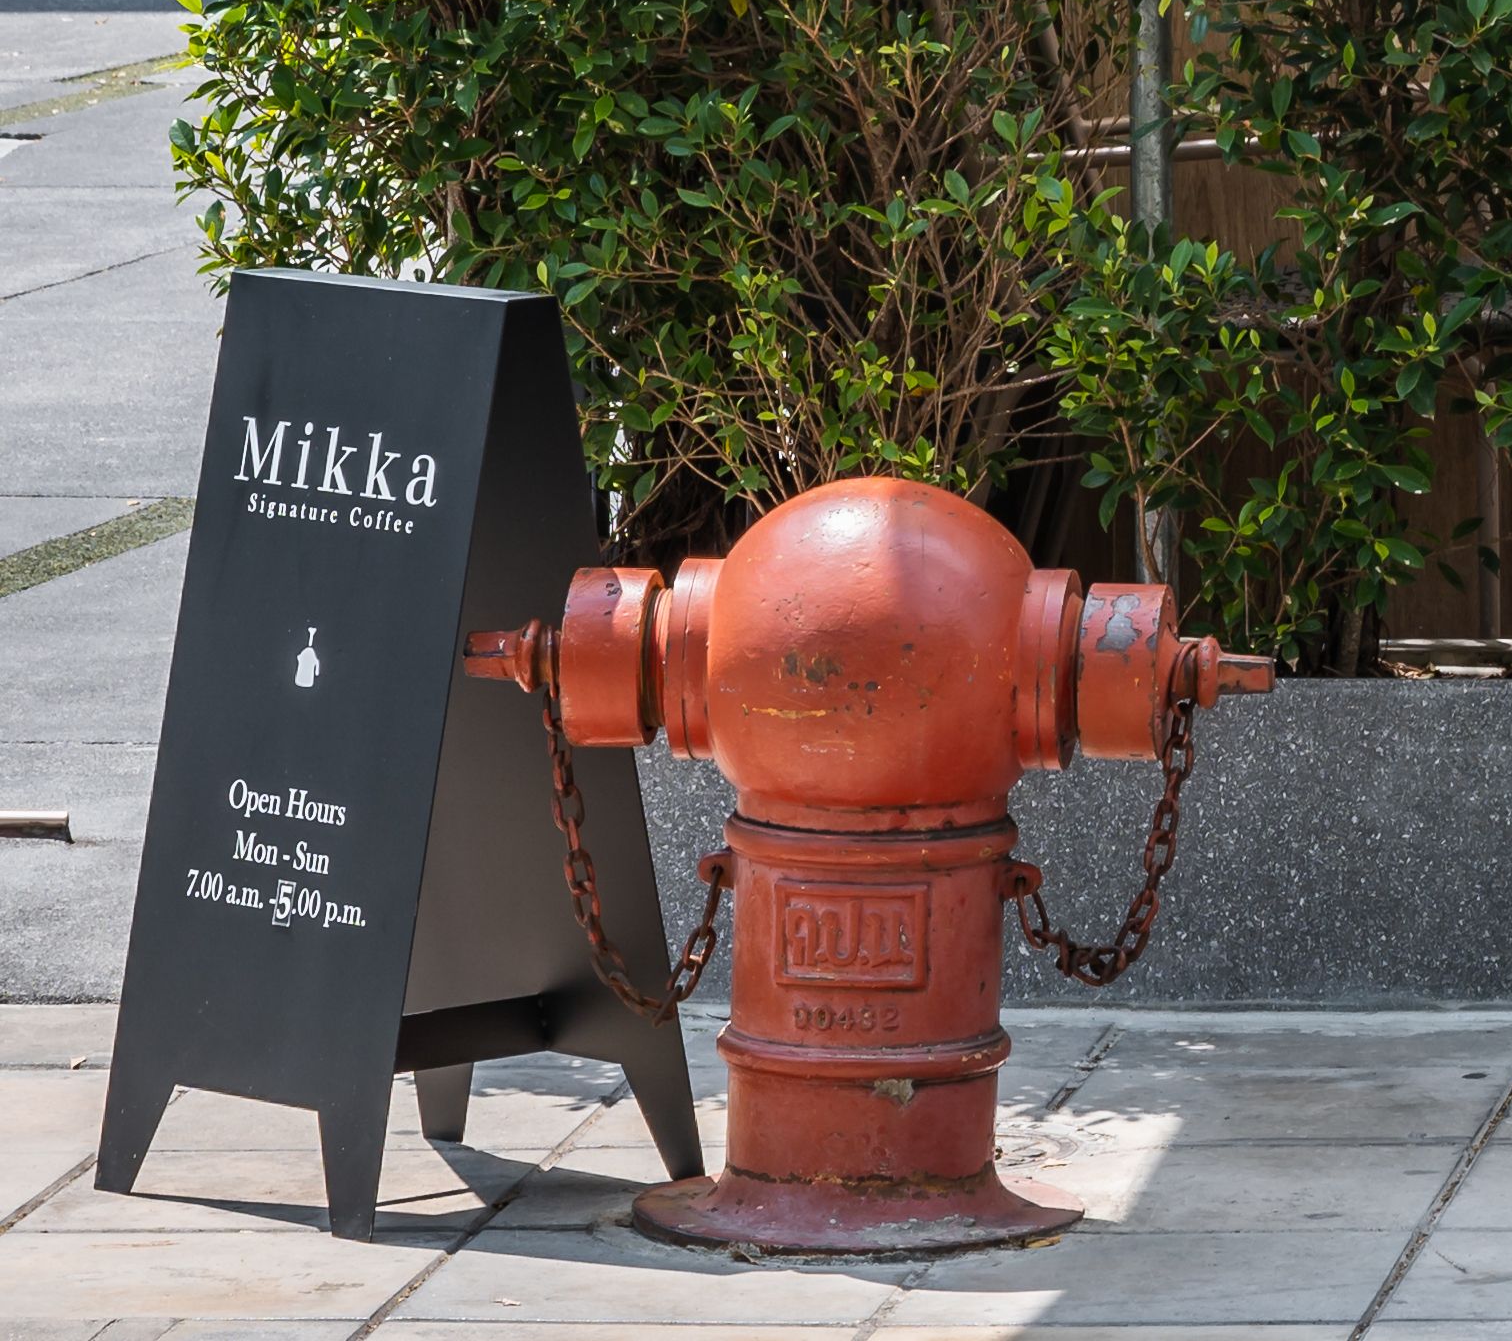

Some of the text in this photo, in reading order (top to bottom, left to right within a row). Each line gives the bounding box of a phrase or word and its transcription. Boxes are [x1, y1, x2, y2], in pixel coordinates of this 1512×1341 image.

[234, 415, 438, 508] Mikka
[247, 492, 415, 534] Signature Coffee
[228, 778, 347, 826] Open Hours
[232, 829, 278, 866] Mon
[292, 840, 330, 875] Sun
[186, 868, 223, 902] 7.00
[225, 884, 264, 909] a.m.
[322, 901, 367, 928] p.m.
